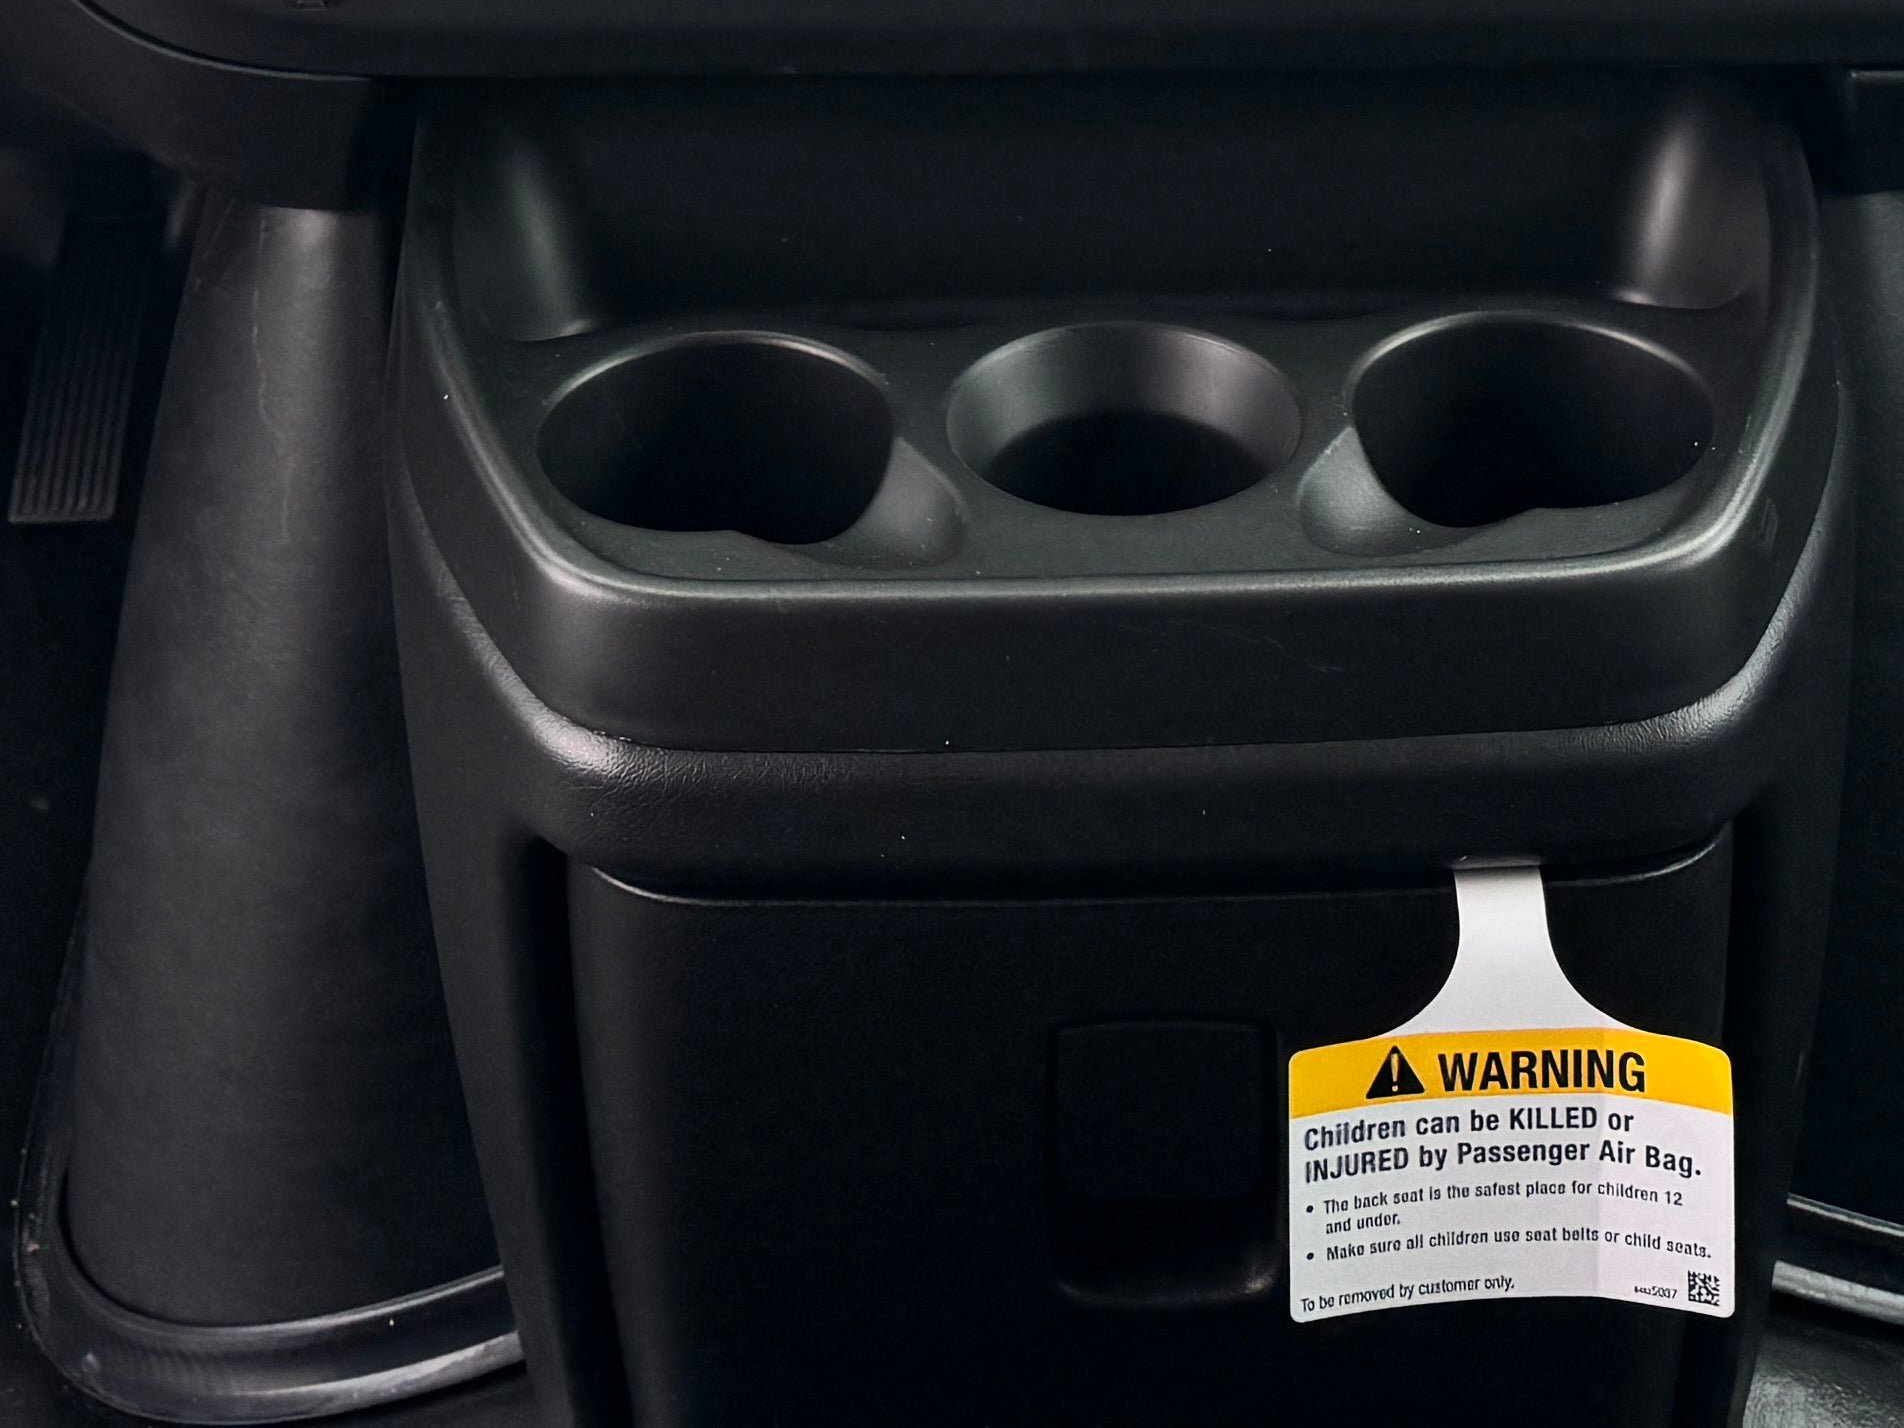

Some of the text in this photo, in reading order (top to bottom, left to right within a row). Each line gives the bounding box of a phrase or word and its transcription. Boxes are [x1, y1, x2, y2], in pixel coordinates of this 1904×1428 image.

[1437, 1049, 1646, 1093] WARNING
[1304, 1106, 1634, 1151] Children can be KILLED or
[1305, 1139, 1701, 1183] INJURED by Passenger Air Bag.
[1323, 1179, 1683, 1214] The back seat is the safest place for children 12
[1325, 1212, 1401, 1235] and under.
[1327, 1227, 1711, 1261] Make sure all children use seat belts or child seats.
[1301, 1274, 1515, 1312] To be removed by customer only.
